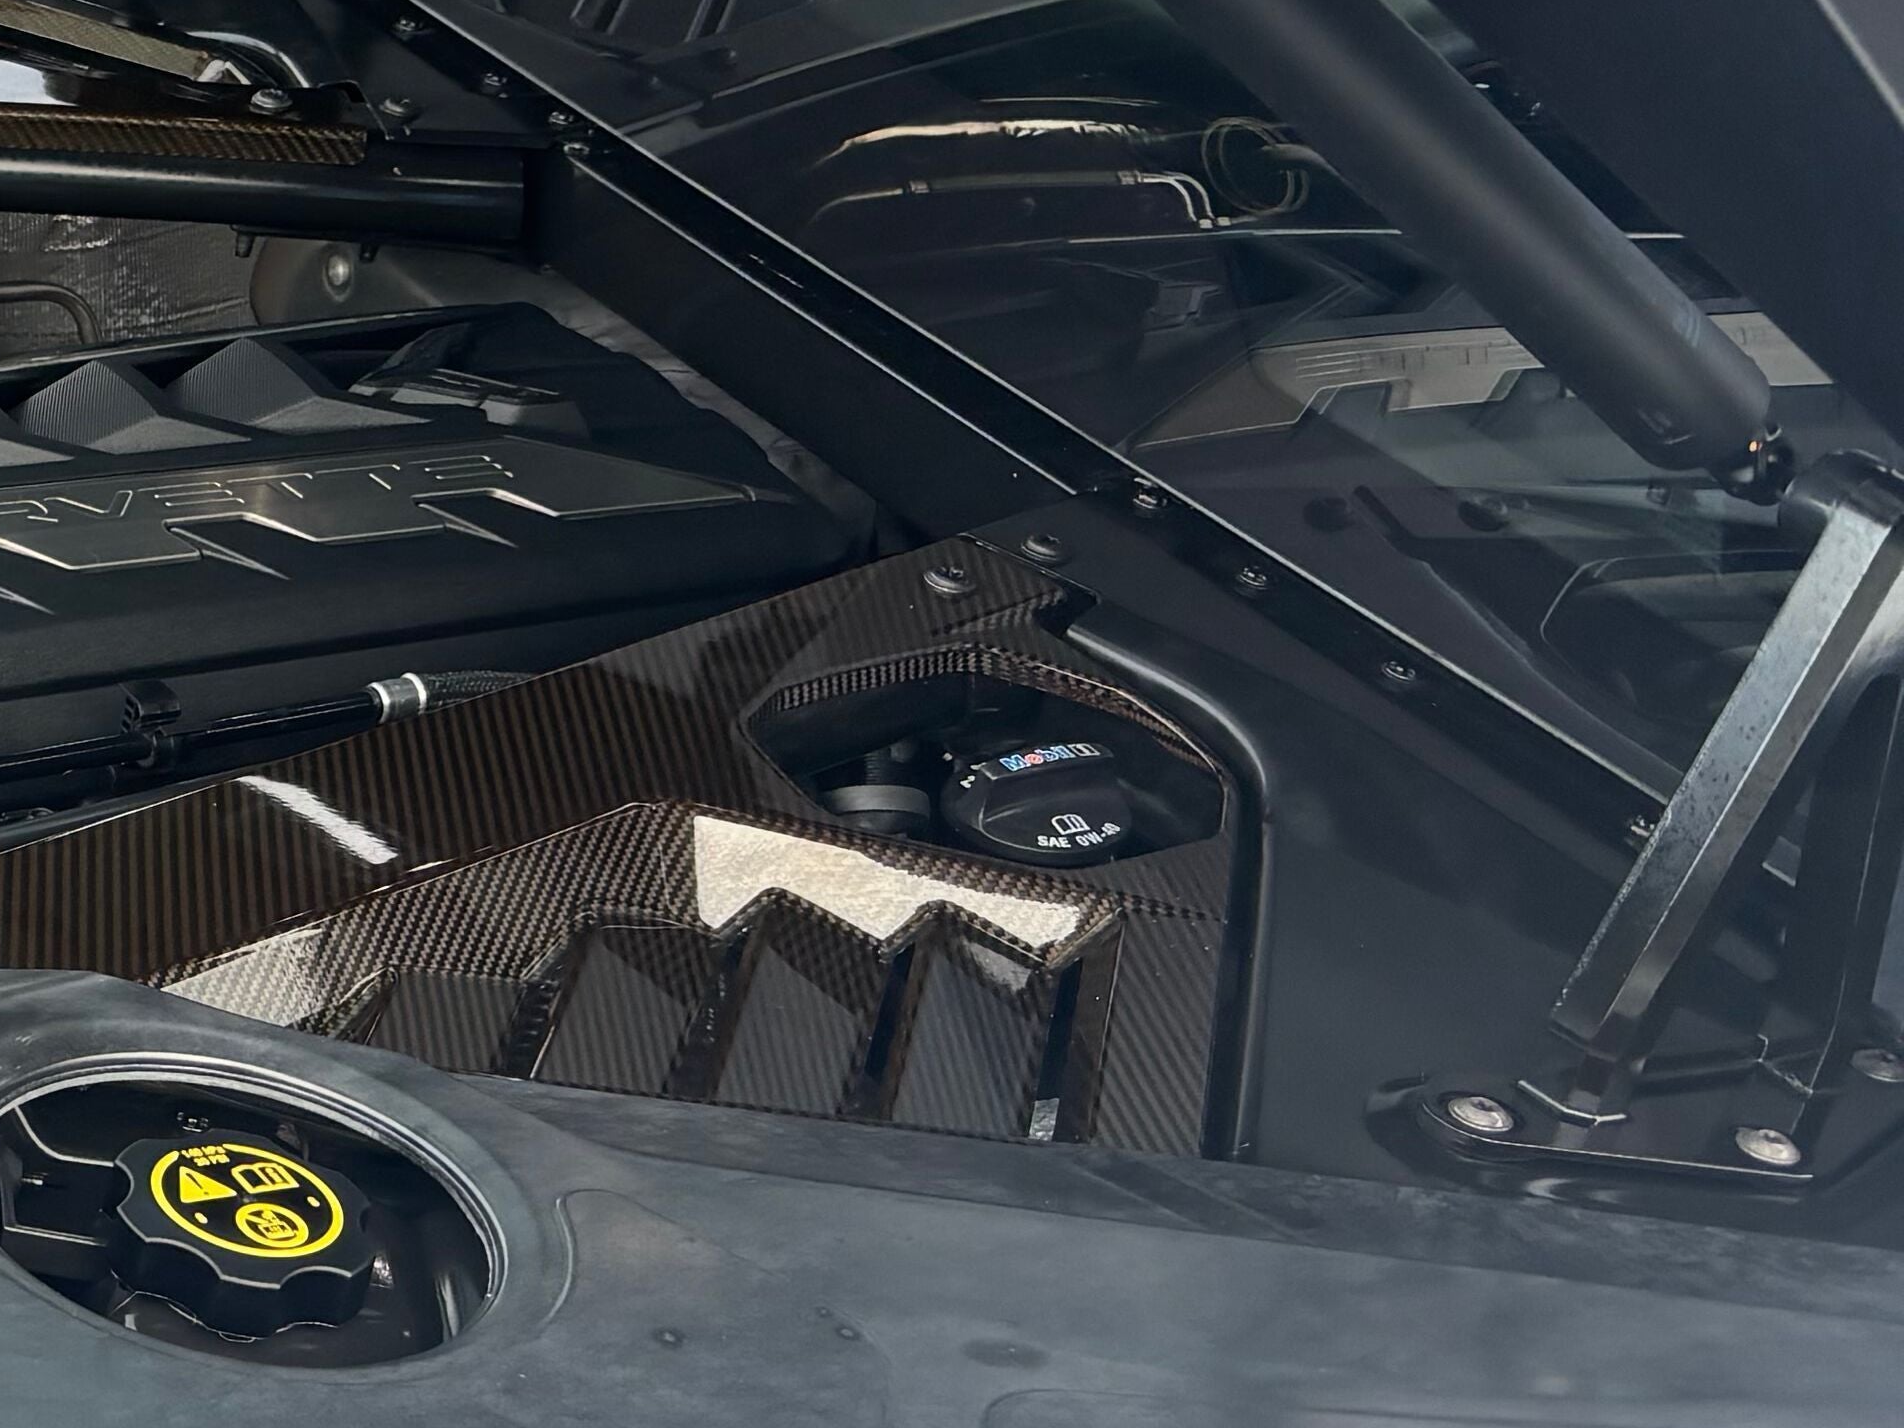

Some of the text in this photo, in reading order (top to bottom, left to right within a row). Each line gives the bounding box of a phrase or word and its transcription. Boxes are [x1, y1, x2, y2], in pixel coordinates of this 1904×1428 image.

[999, 744, 1073, 772] Mobil
[1037, 822, 1121, 849] SAE 0W-40
